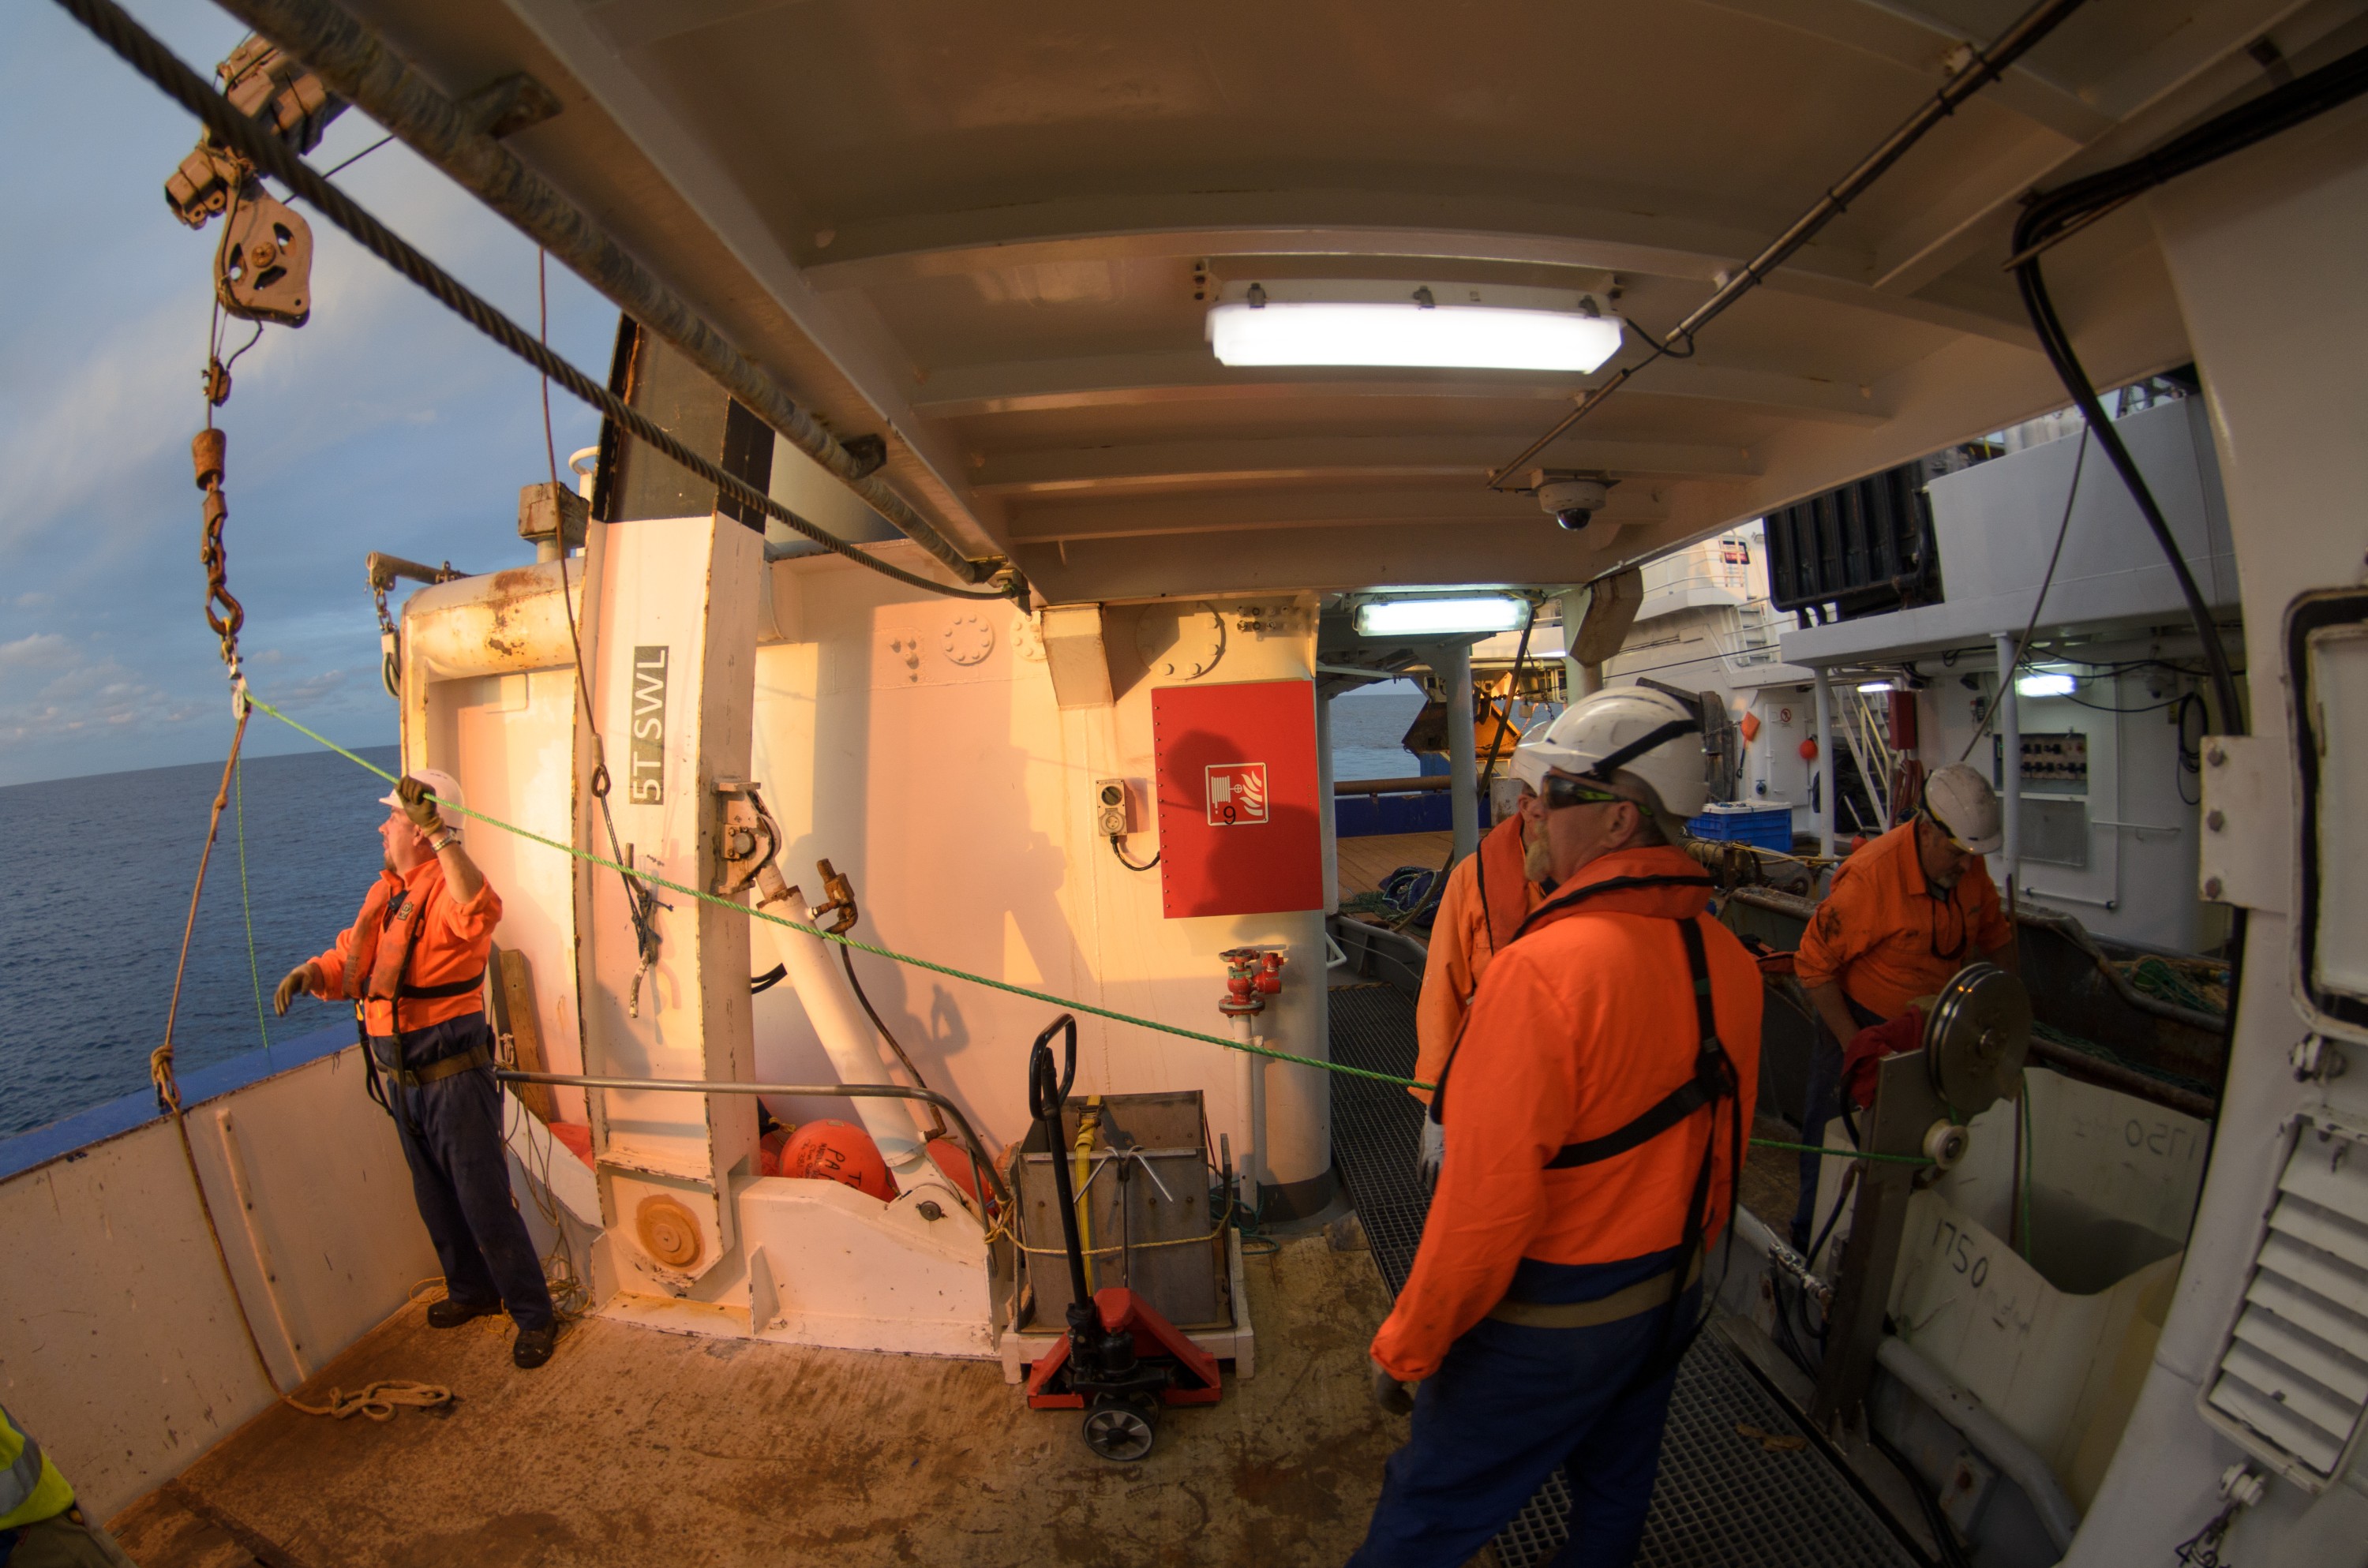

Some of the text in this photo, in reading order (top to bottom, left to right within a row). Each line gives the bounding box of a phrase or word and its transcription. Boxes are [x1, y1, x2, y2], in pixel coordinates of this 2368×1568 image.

[633, 649, 665, 801] 5T SWL
[1223, 806, 1236, 825] 9
[1932, 1218, 1988, 1288] 1750
